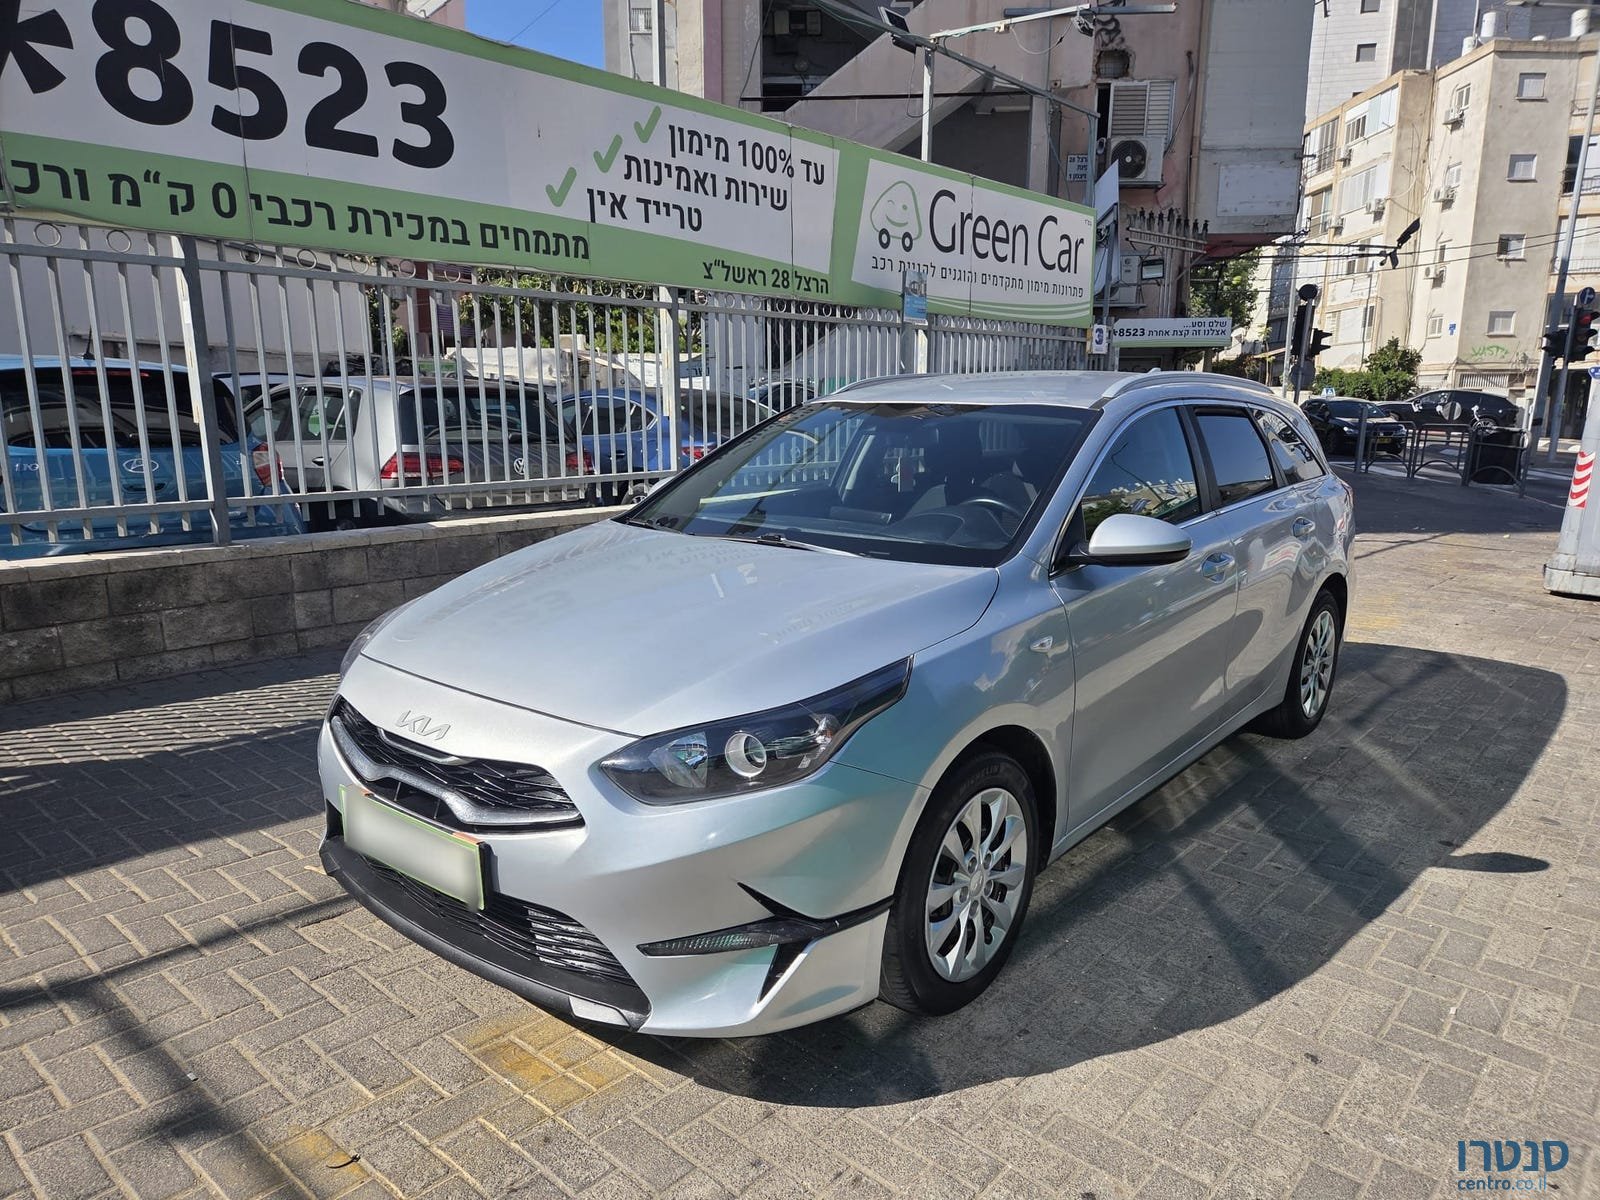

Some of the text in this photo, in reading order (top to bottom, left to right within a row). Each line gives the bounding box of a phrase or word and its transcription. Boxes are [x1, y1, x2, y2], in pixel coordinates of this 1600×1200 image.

[668, 124, 825, 185] עד 100% מימון
[0, 159, 90, 201] ורכ
[624, 154, 788, 211] שירות ואמינות
[211, 182, 237, 219] 0
[587, 187, 703, 231] טרייד אין
[250, 193, 336, 231] רכבי
[347, 205, 470, 246] במכירת
[929, 189, 1085, 274] Green Car
[480, 222, 590, 260] מתמחים
[871, 255, 894, 271] רכב
[771, 268, 790, 289] 28
[794, 270, 829, 294] הרצל
[940, 266, 977, 284] והוגנים
[981, 272, 1024, 291] מתקדמים
[1027, 279, 1049, 294] מימון
[1051, 283, 1084, 298] פתרונות
[1147, 329, 1170, 337] אחרת
[1171, 329, 1190, 338] קצת
[1203, 328, 1226, 336] אצלנו
[1208, 319, 1227, 328] שלם
